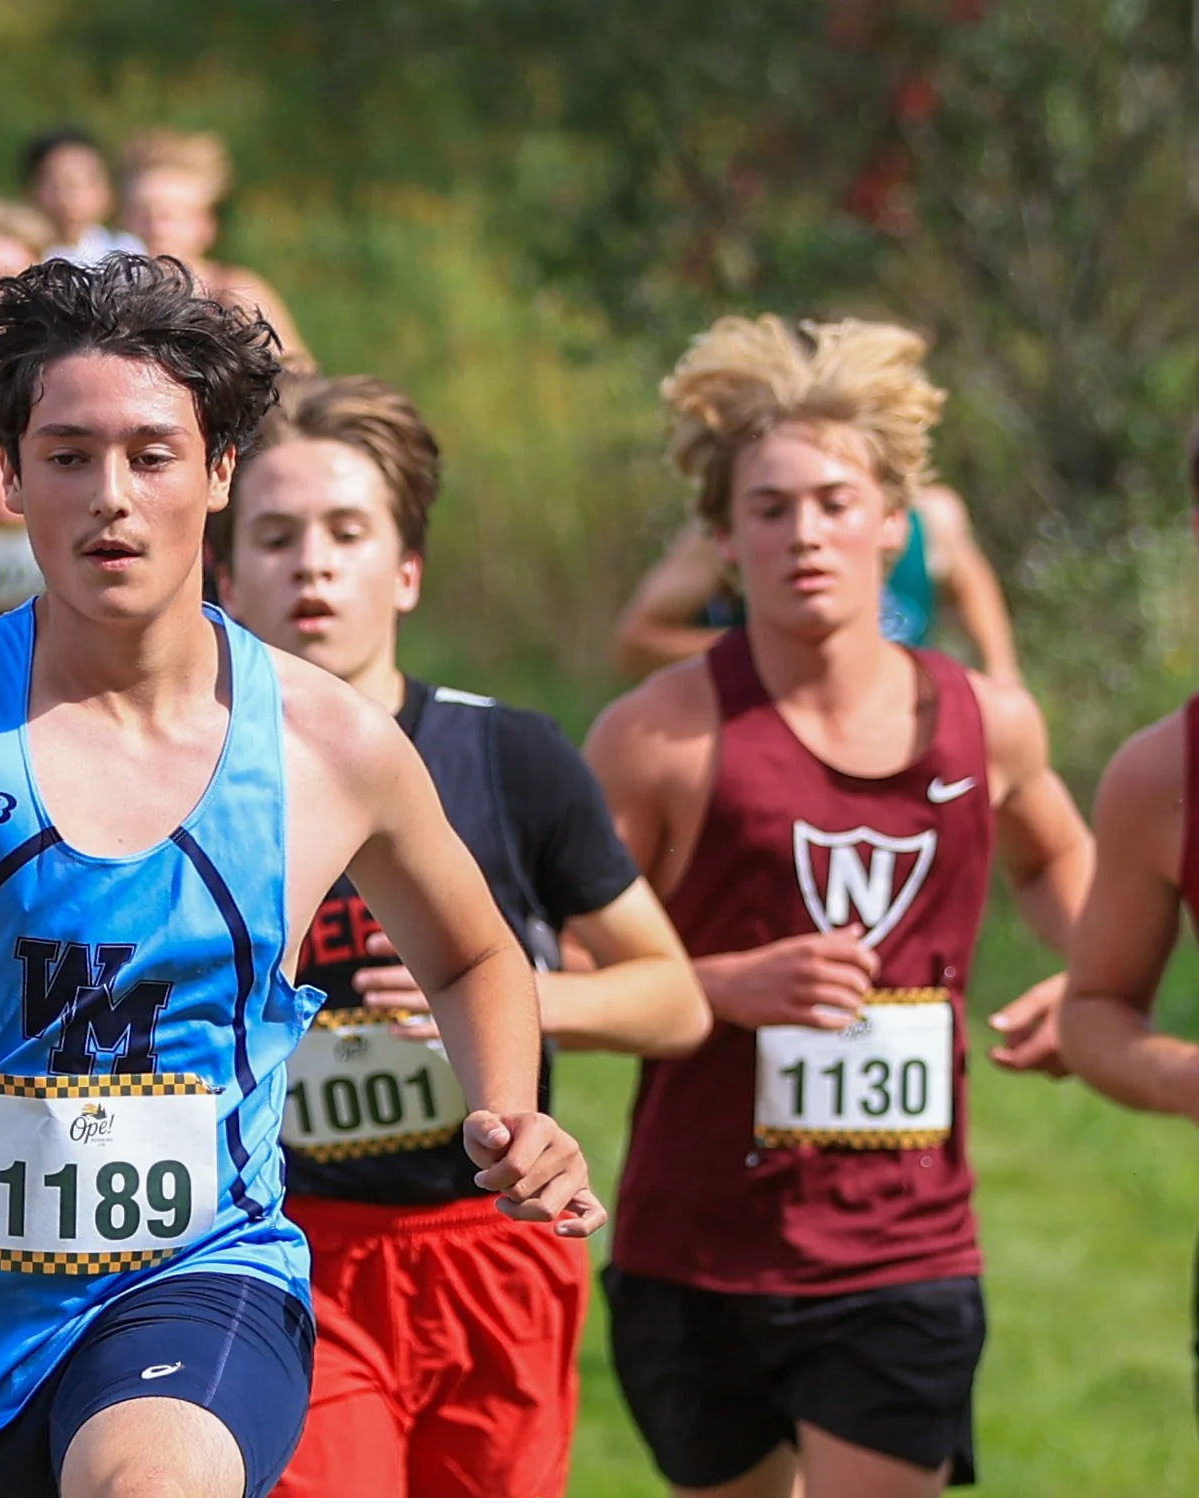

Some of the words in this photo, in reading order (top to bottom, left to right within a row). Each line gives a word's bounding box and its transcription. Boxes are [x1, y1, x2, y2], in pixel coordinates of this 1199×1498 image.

[826, 846, 896, 927] N
[14, 936, 174, 1075] WM
[286, 1065, 439, 1136] 1001
[779, 1058, 929, 1117] 1130
[69, 1113, 115, 1144] Ope!
